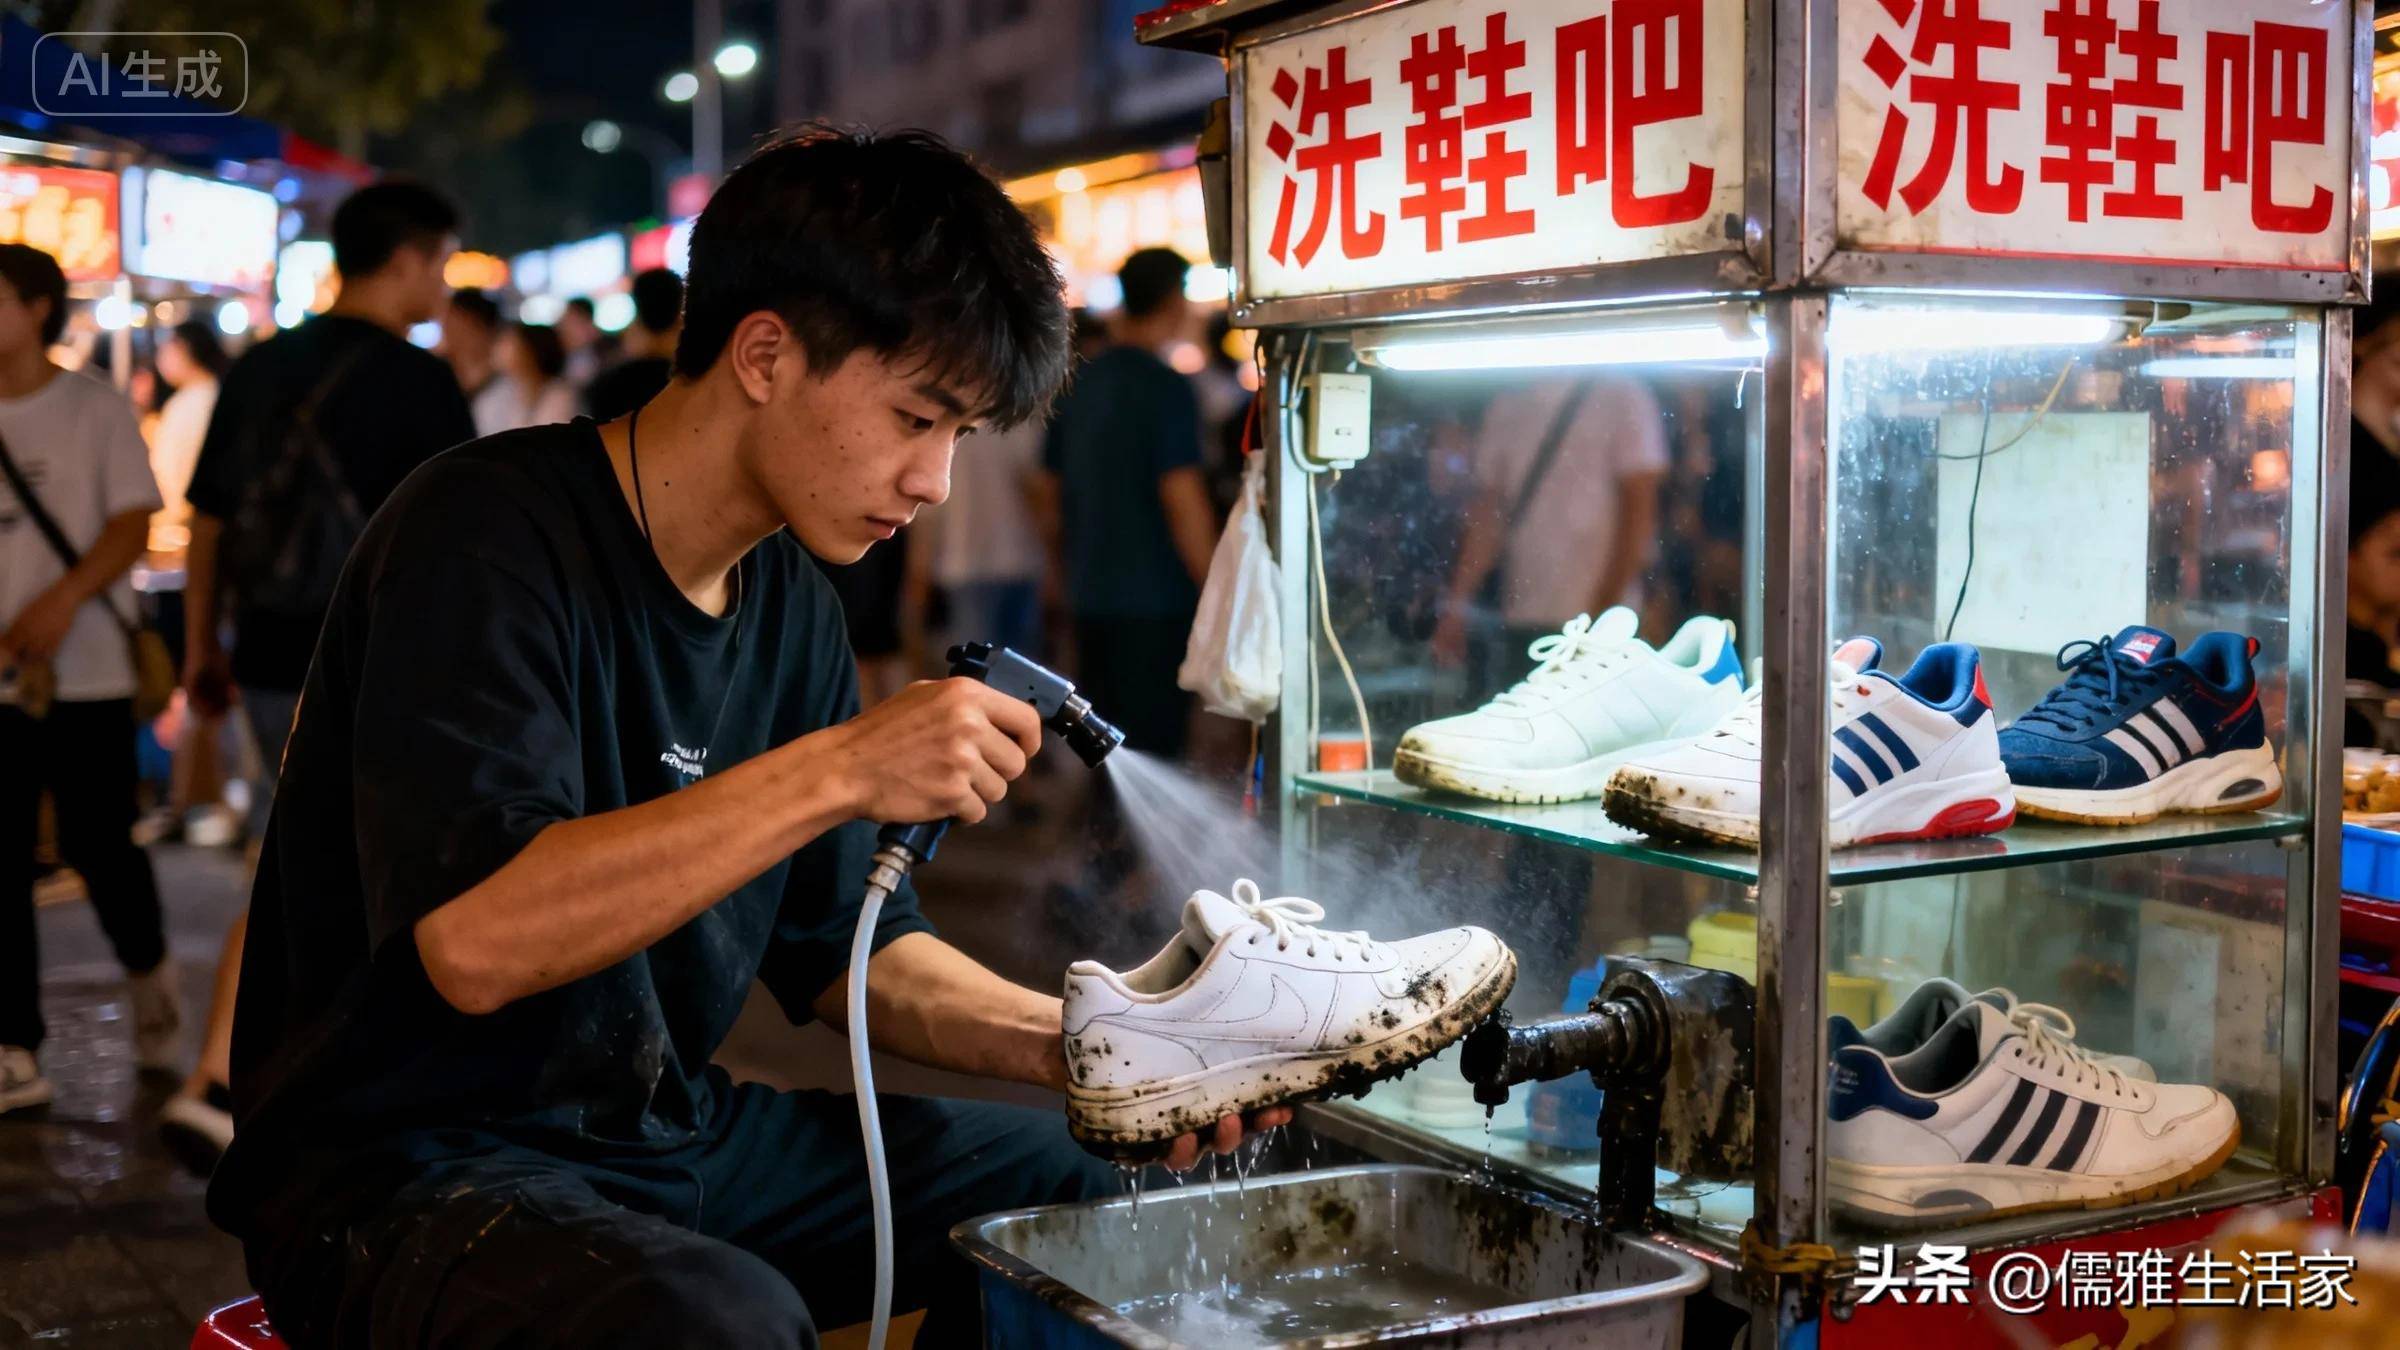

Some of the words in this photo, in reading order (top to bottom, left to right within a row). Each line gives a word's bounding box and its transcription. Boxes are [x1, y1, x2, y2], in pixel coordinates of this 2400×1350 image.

[1266, 0, 1715, 270] 洗鞋吧
[1861, 0, 2334, 234] 洗鞋吧
